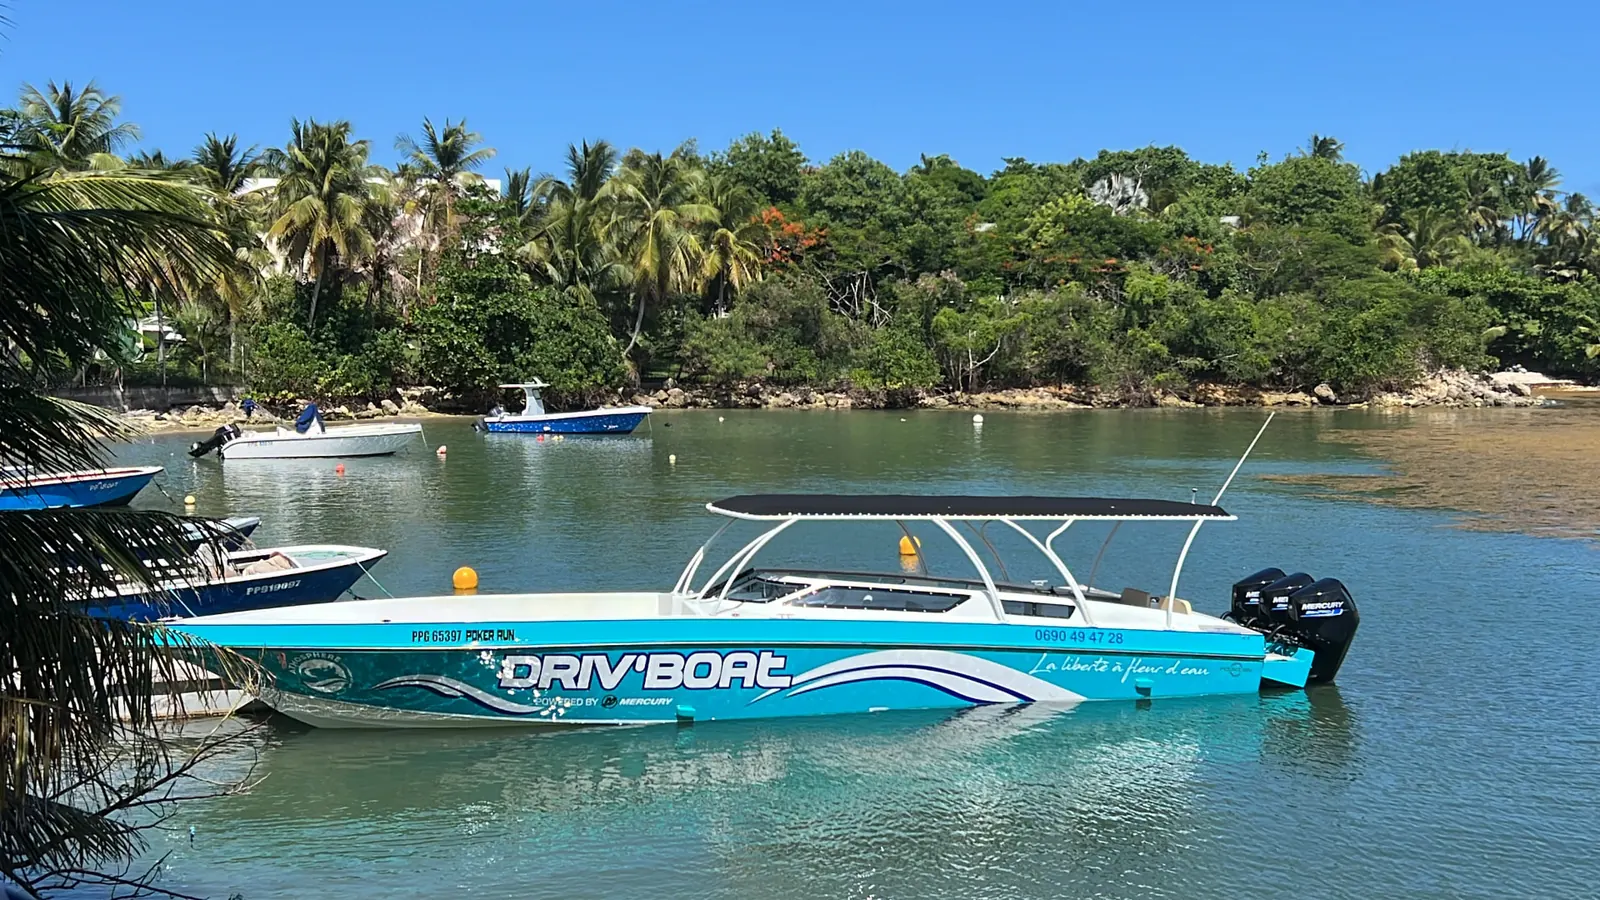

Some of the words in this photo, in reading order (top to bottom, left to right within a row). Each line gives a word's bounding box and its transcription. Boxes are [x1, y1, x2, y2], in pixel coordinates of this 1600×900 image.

[1301, 601, 1344, 611] MERCURY
[412, 630, 430, 642] PPG
[432, 630, 462, 642] 65397
[465, 629, 494, 641] POKER
[496, 629, 515, 641] RUN
[1035, 629, 1067, 641] 0690
[1070, 631, 1085, 642] 49
[1089, 631, 1104, 643] 47
[1108, 632, 1124, 644] 28
[1028, 652, 1058, 675] La
[1120, 656, 1164, 684] fleur
[533, 697, 584, 706] POWERED
[585, 697, 599, 706] BY
[619, 697, 673, 706] MERCURY
